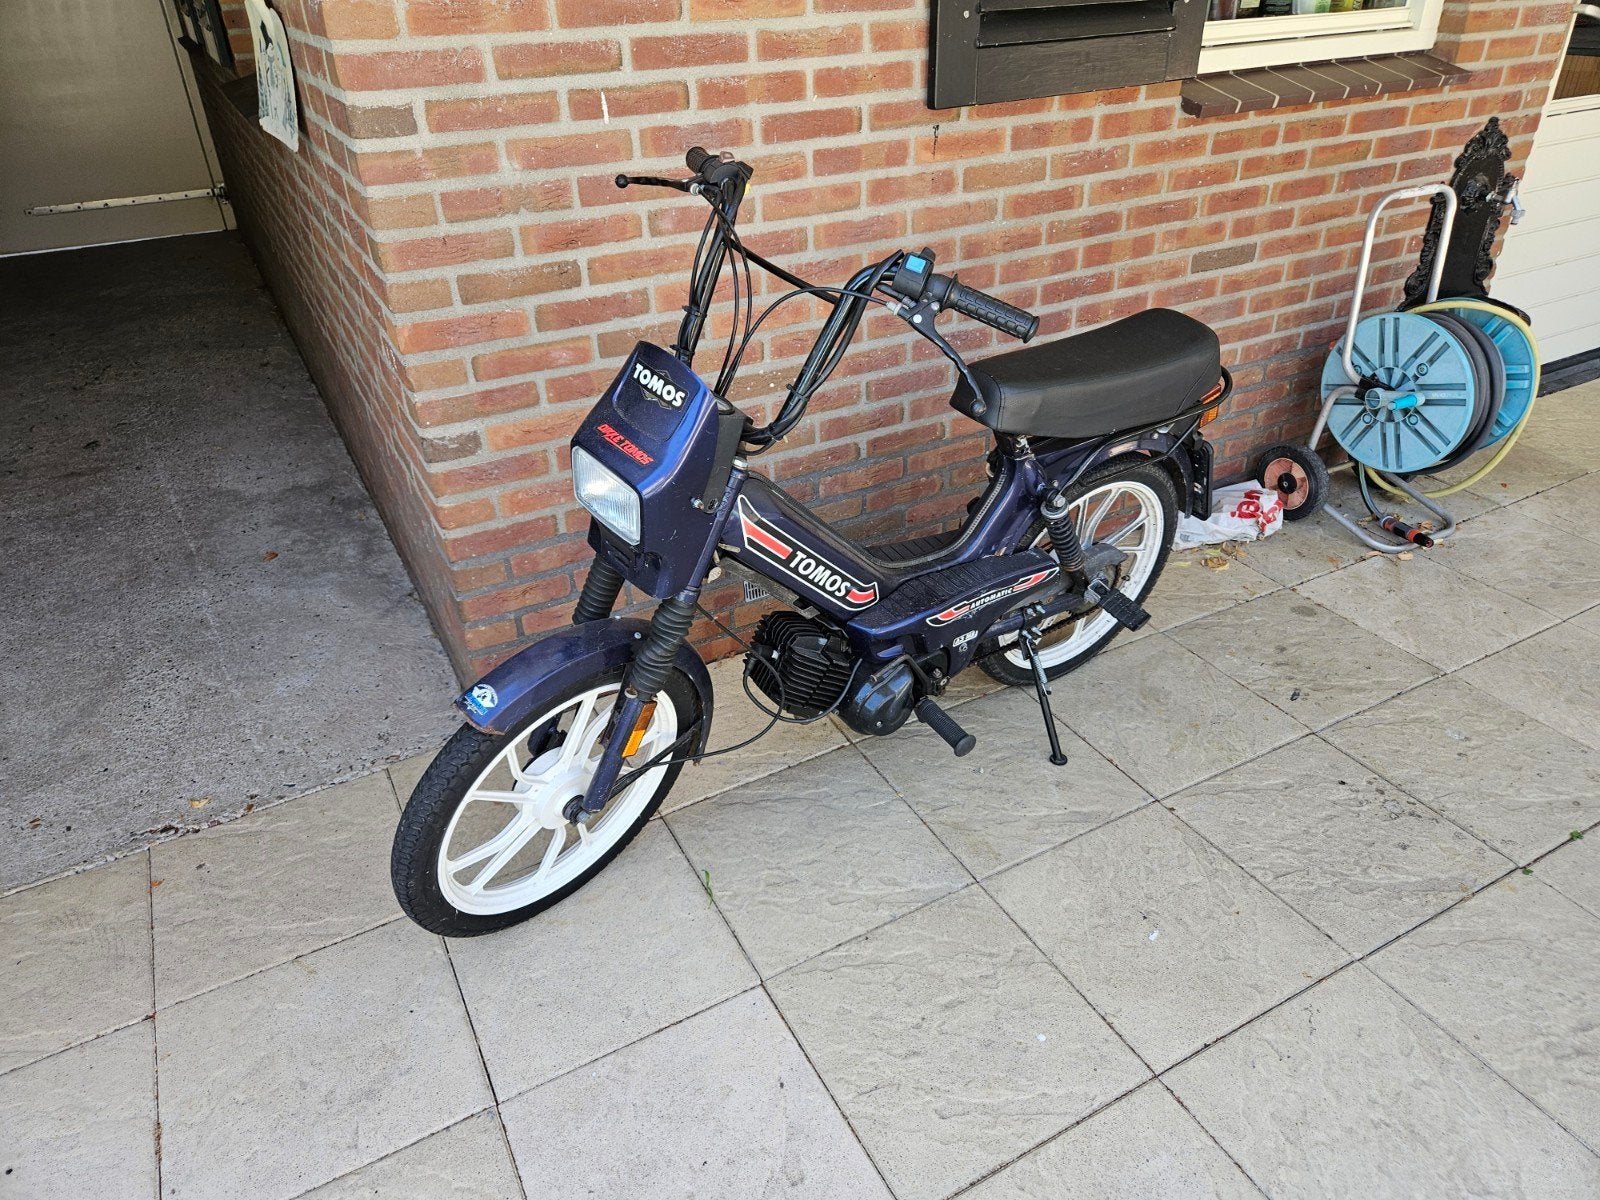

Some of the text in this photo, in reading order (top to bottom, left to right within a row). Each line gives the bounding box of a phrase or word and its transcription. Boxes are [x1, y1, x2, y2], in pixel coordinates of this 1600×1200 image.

[633, 363, 685, 407] TOMOS
[789, 551, 851, 597] TOMOS
[970, 587, 1012, 608] AUTOMATIC
